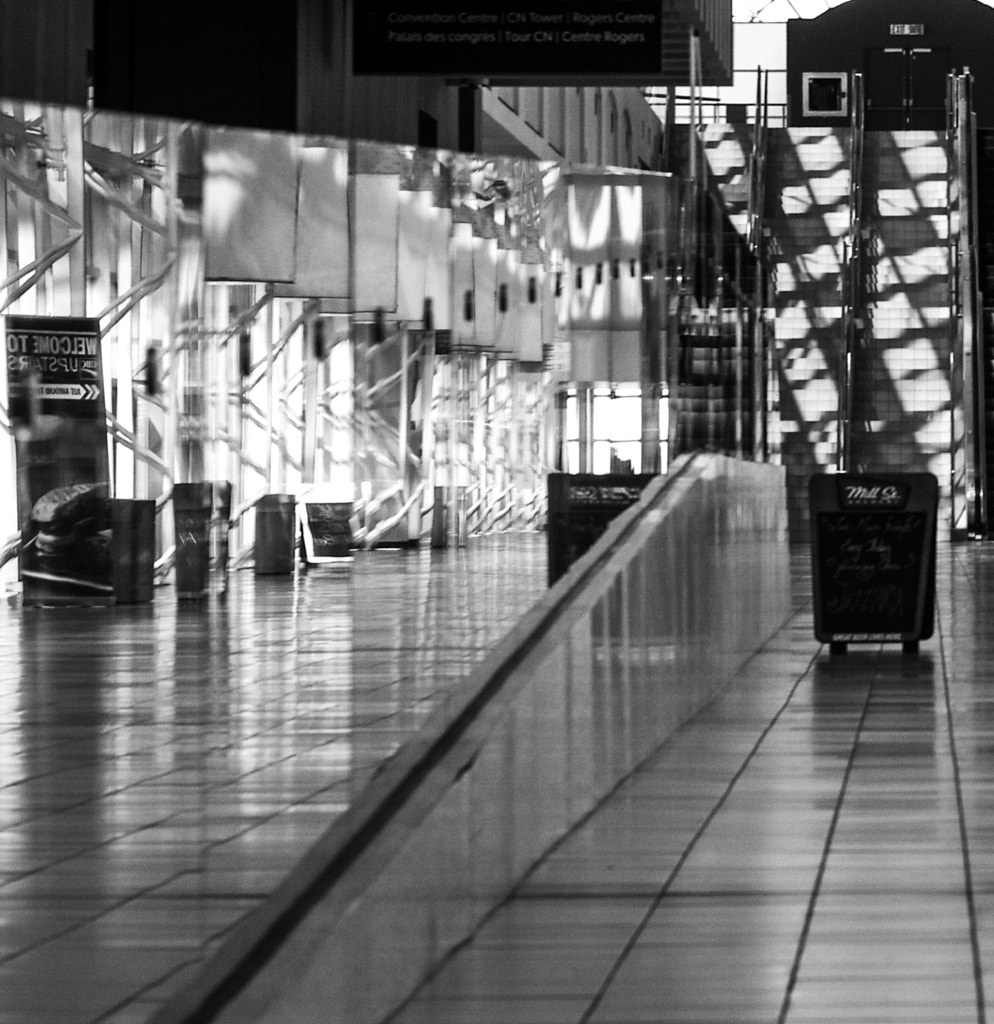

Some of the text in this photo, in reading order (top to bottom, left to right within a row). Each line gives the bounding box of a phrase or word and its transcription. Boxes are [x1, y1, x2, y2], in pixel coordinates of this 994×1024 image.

[388, 11, 656, 26] Convention Centre CN Tower Rogers Centre
[388, 31, 646, 45] Palais des congrès Tour CN Centre Rogers
[845, 485, 881, 499] Mill
